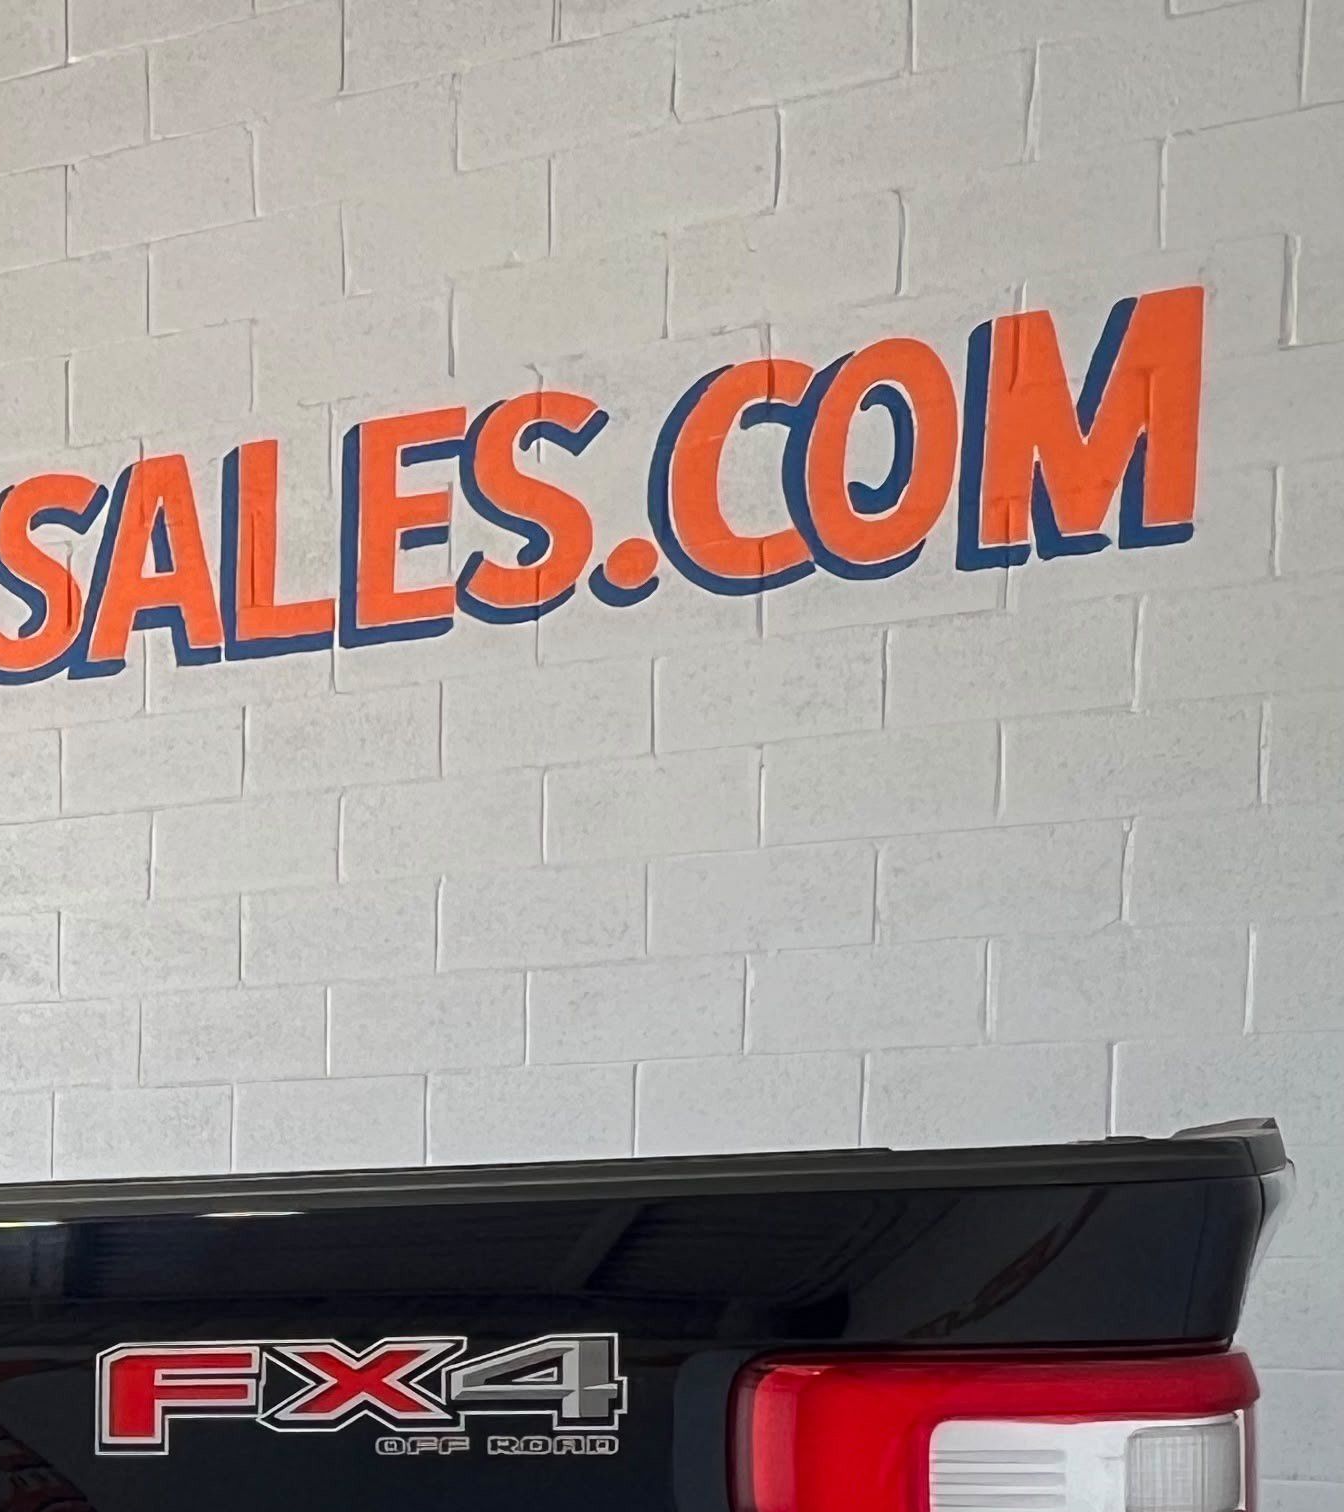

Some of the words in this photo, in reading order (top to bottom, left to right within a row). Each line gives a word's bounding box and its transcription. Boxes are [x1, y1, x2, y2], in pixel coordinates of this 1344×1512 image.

[96, 1333, 628, 1455] FX4
[375, 1436, 470, 1456] OFF
[487, 1436, 619, 1456] ROAD
